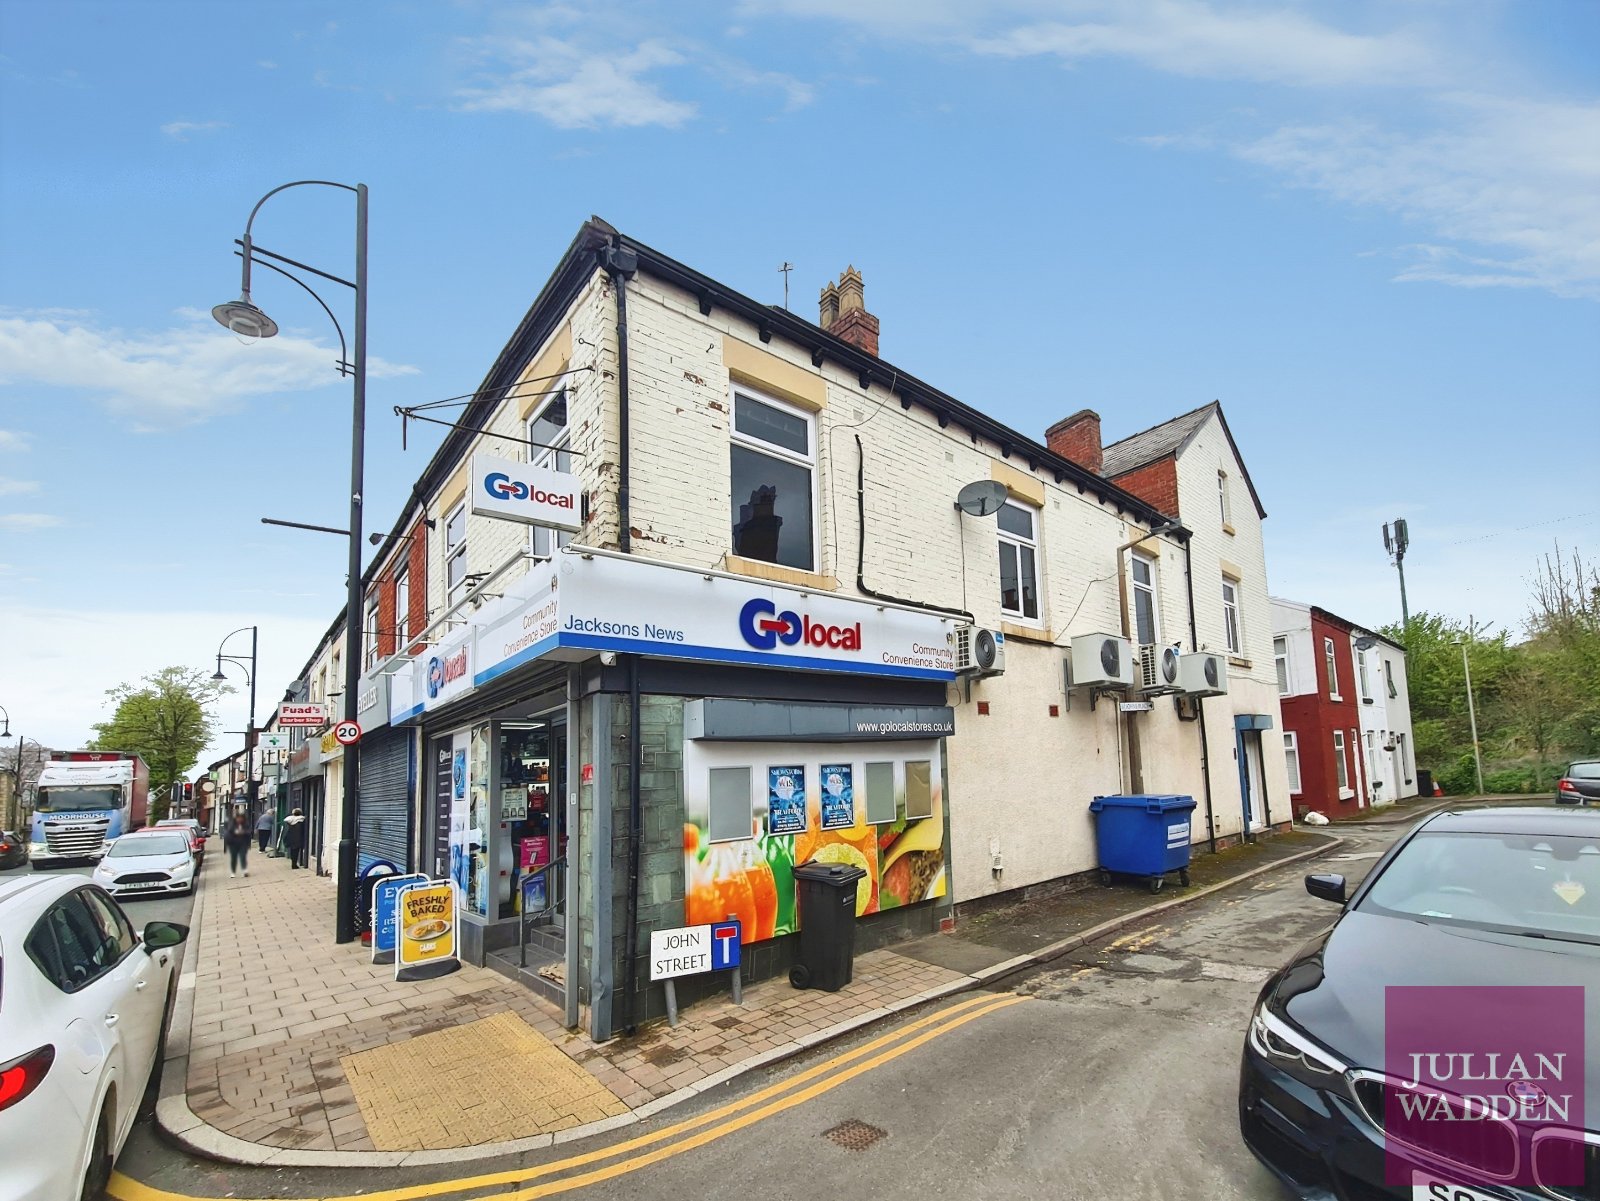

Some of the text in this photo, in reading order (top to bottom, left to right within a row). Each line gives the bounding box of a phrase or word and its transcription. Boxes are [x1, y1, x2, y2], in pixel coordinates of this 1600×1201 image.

[523, 600, 558, 629] Community
[564, 614, 684, 642] Jacksons News
[503, 619, 557, 657] Convenience Store
[912, 643, 954, 660] Community
[882, 652, 954, 670] Convenience Store
[282, 706, 320, 714] Fuad's
[338, 727, 357, 737] 20
[857, 721, 953, 734] www.golocalstores.co.uk
[48, 812, 106, 821] MOORHOUSE
[406, 896, 450, 910] FRESHLY
[410, 905, 445, 918] BAKED
[662, 933, 700, 950] JOHN
[656, 953, 707, 975] STREET
